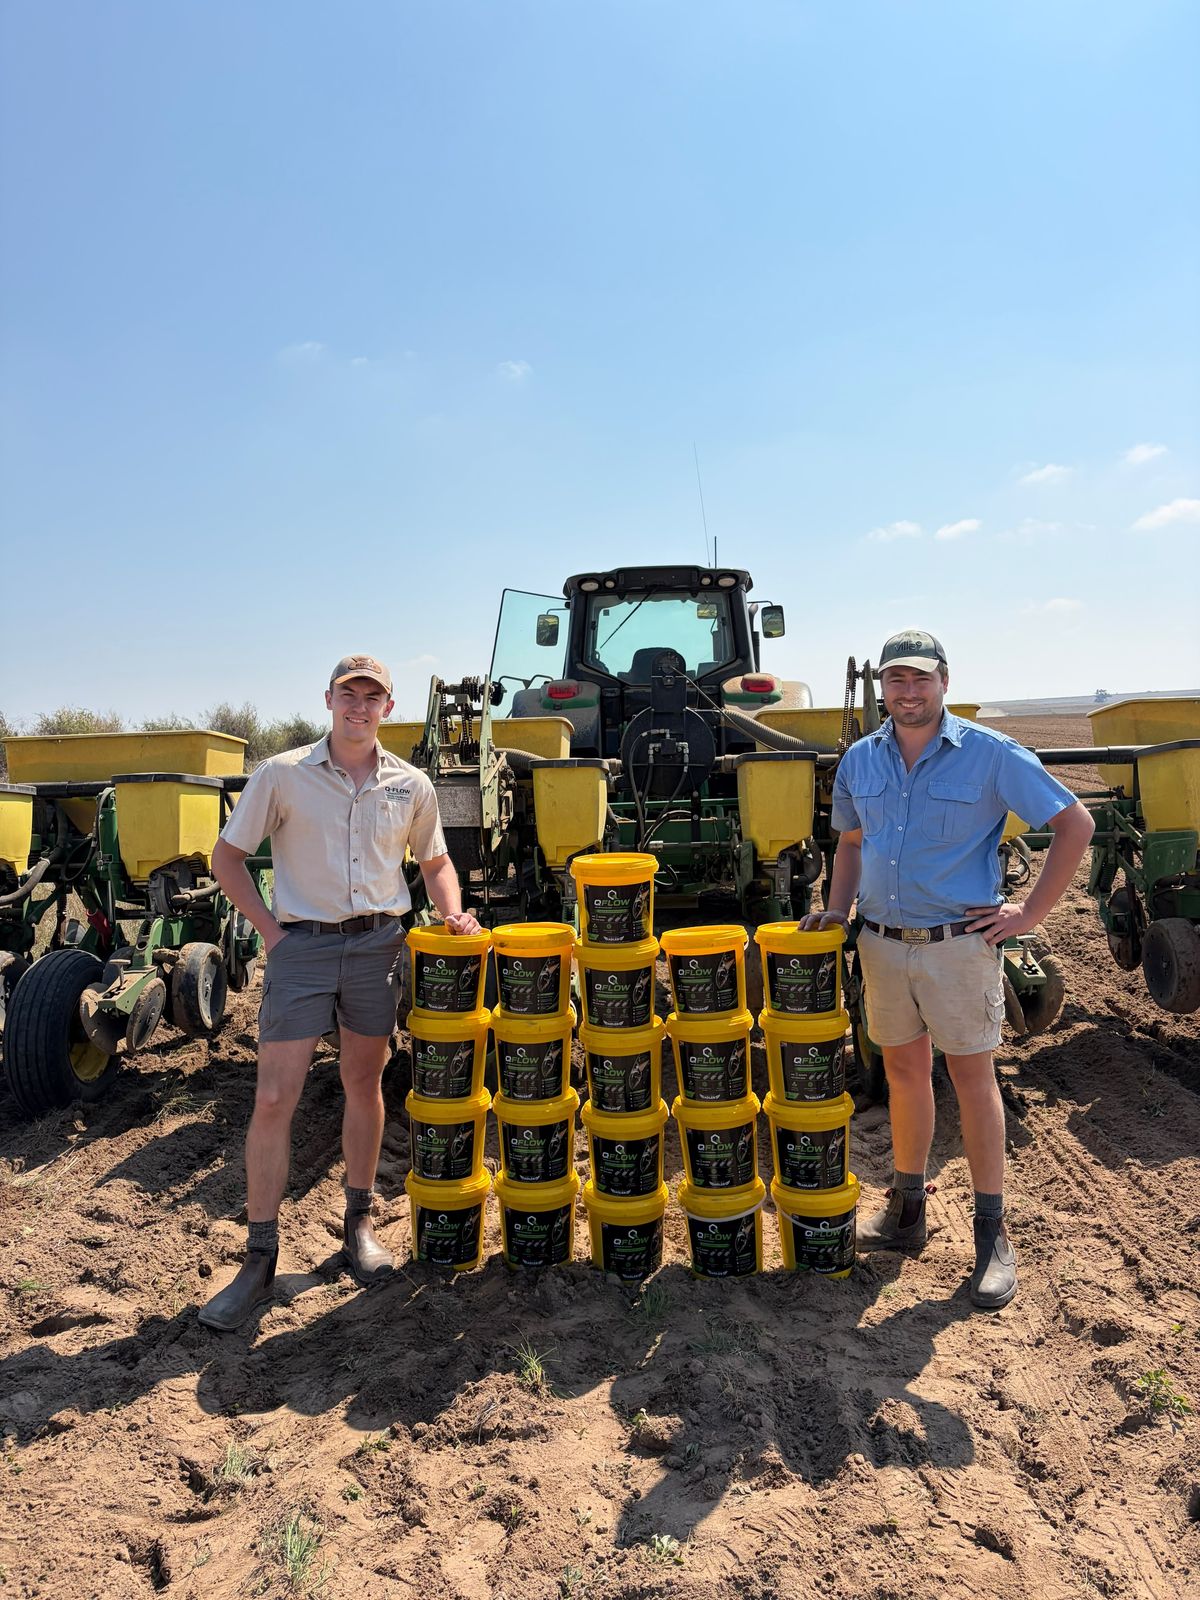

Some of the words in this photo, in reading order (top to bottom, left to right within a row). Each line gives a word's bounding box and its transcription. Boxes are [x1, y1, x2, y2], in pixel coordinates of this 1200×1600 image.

[423, 966, 458, 975] QFLOW
[503, 968, 535, 977] QFLOW
[777, 967, 814, 975] QFLOW
[417, 1052, 448, 1062] QFLOW
[505, 1056, 539, 1064] QFLOW
[794, 1055, 830, 1064] QFLOW
[593, 1067, 626, 1076] QFLOW
[417, 1135, 449, 1144] QFLOW
[787, 1144, 824, 1152] QFLOW
[602, 1152, 638, 1160] QFLOW
[514, 1223, 549, 1231] QFLOW
[614, 1236, 649, 1245] QFLOW
[697, 1232, 731, 1240] QFLOW
